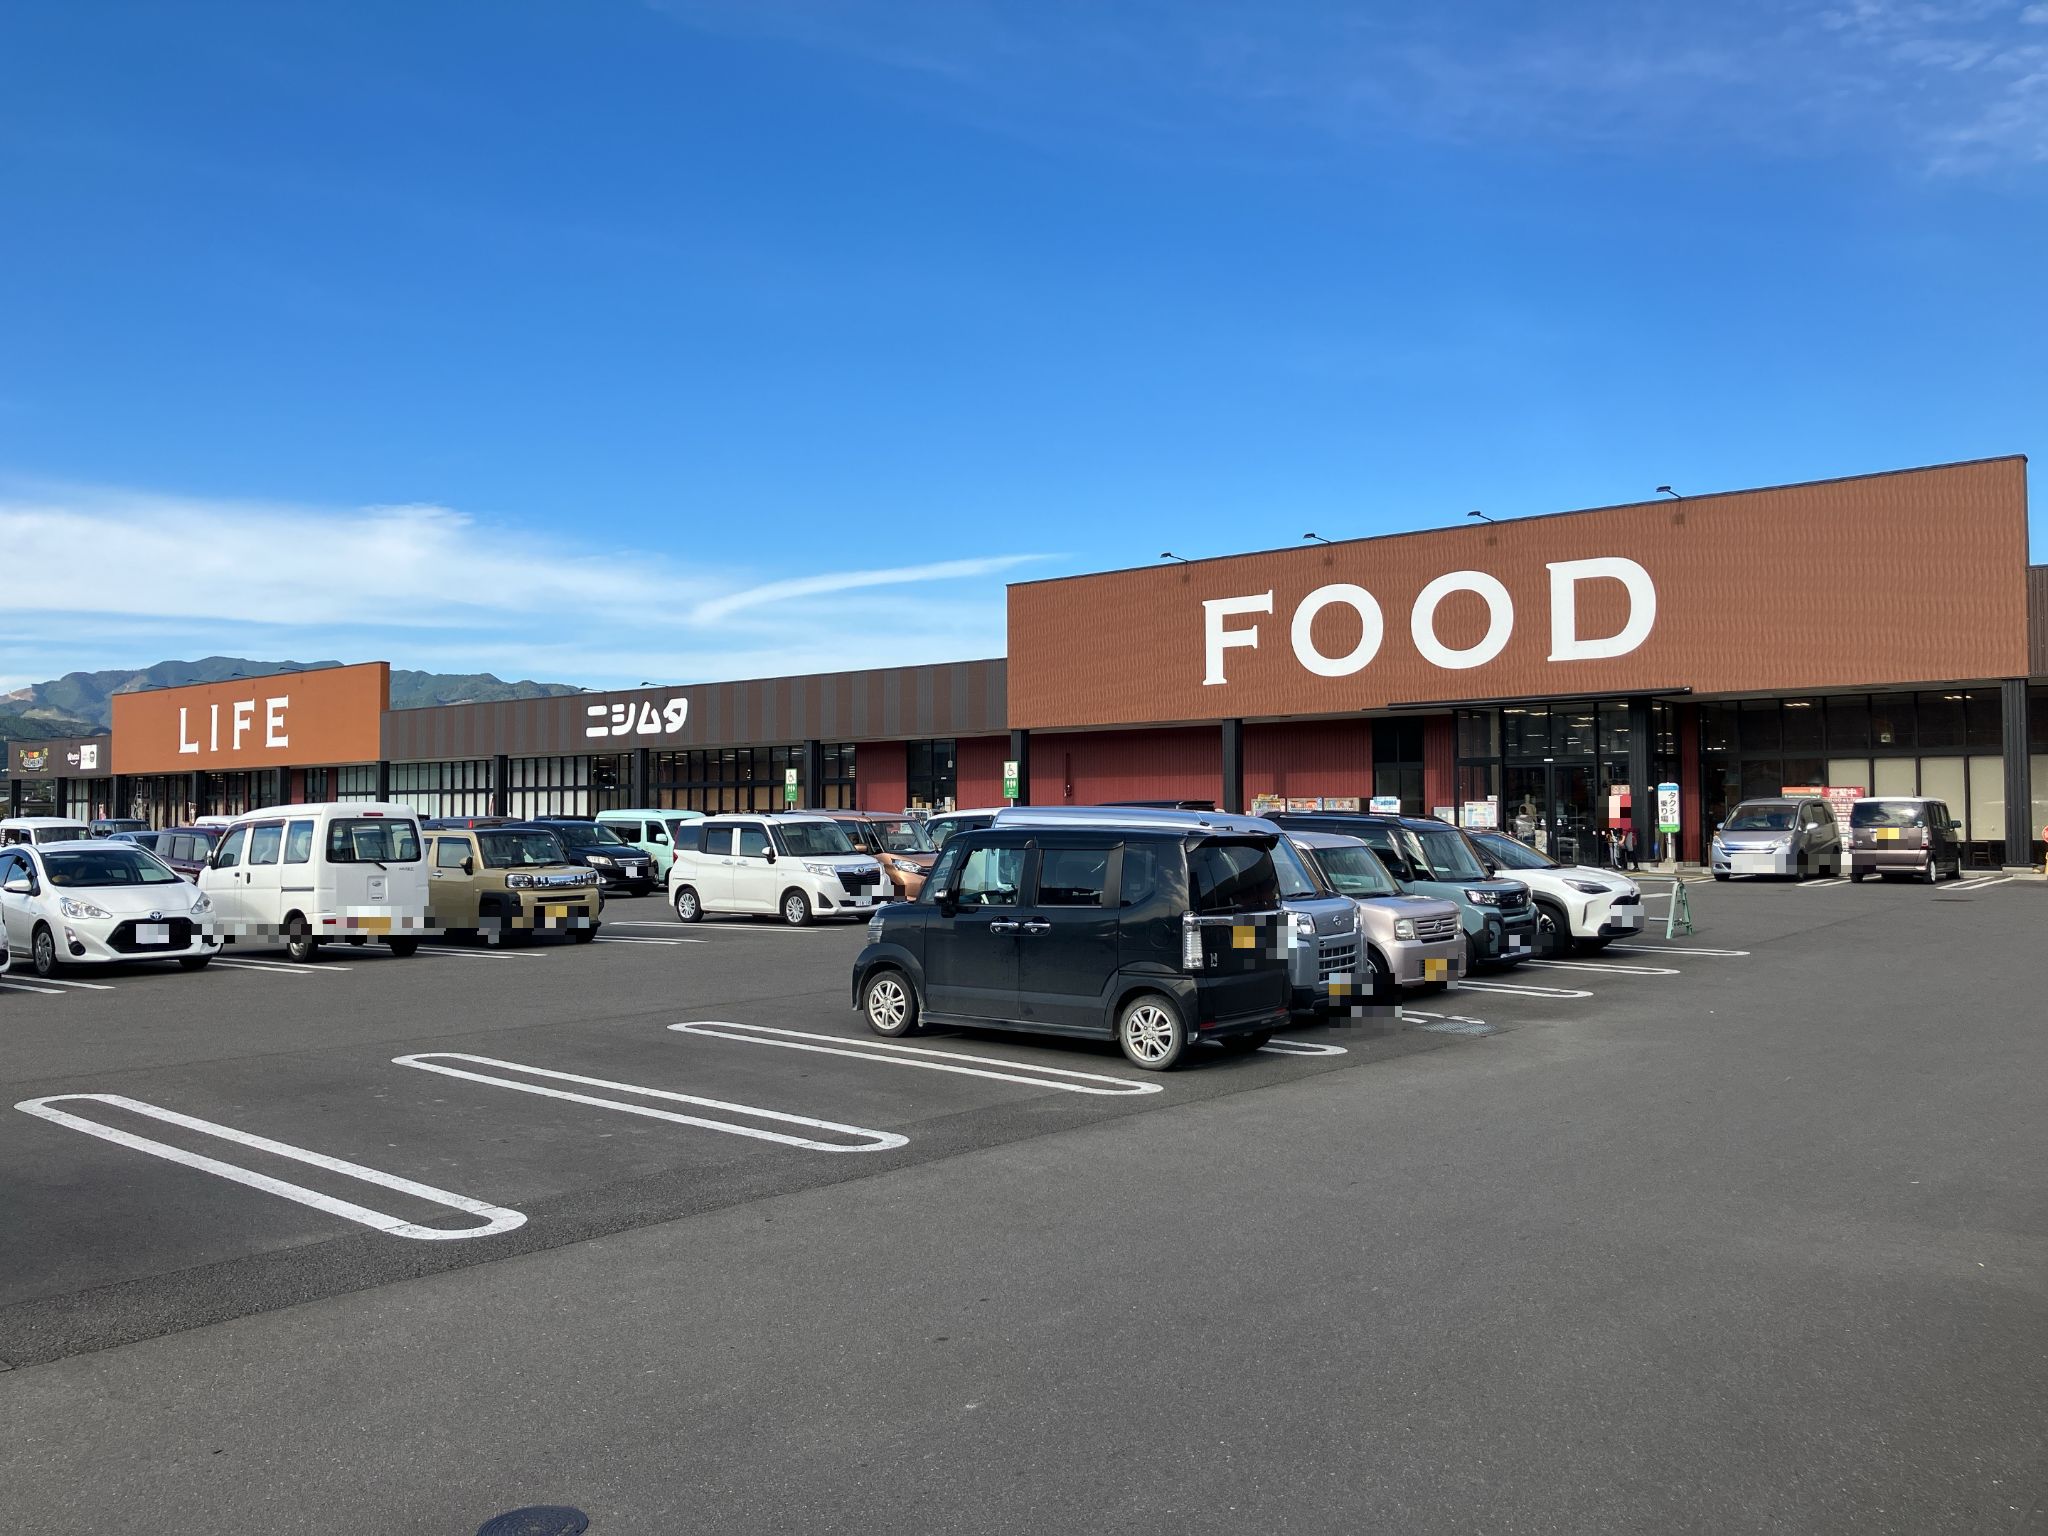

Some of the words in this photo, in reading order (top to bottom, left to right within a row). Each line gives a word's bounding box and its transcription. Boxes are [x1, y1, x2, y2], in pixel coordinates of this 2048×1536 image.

[1202, 556, 1657, 686] FOOD
[178, 694, 289, 755] LIFE
[585, 697, 688, 738] ニシムタ
[1660, 799, 1669, 823] 乗り場
[1668, 791, 1677, 823] タクシー
